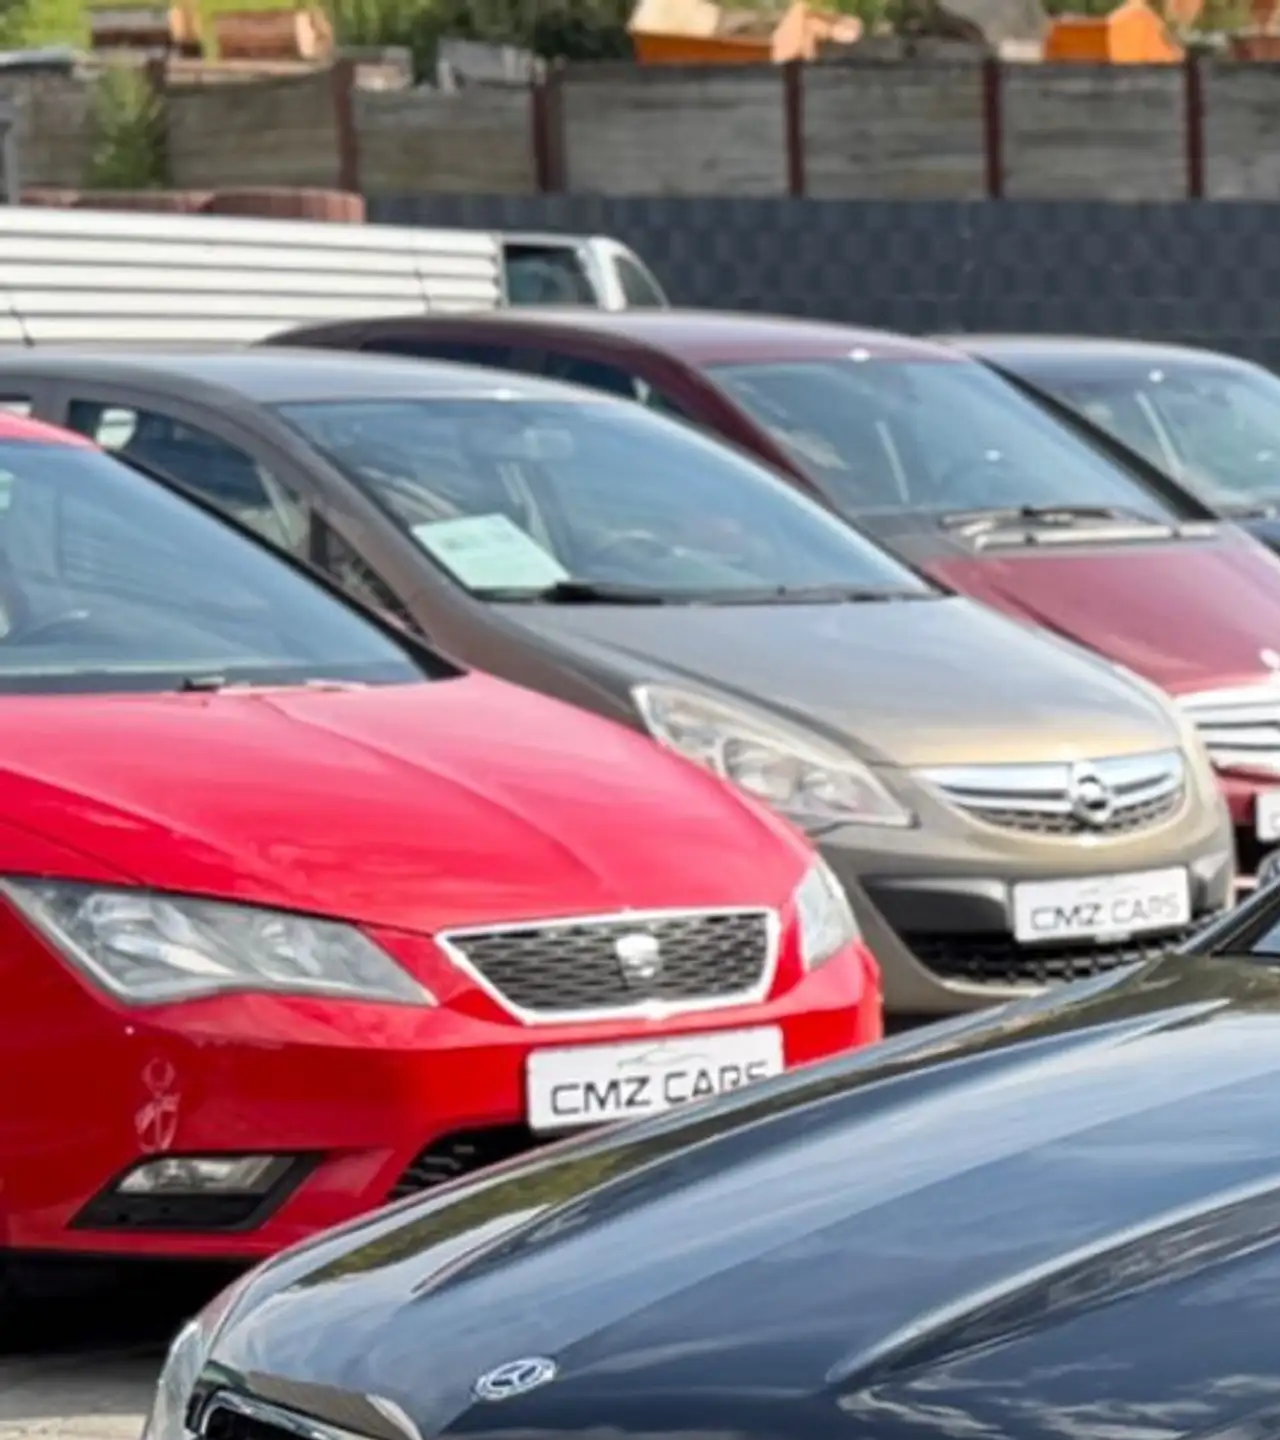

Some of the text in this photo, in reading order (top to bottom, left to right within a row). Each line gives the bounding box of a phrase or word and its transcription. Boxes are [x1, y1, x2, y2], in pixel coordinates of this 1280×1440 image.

[1030, 892, 1182, 932] CMZ CARS
[551, 1076, 652, 1115] CMZ
